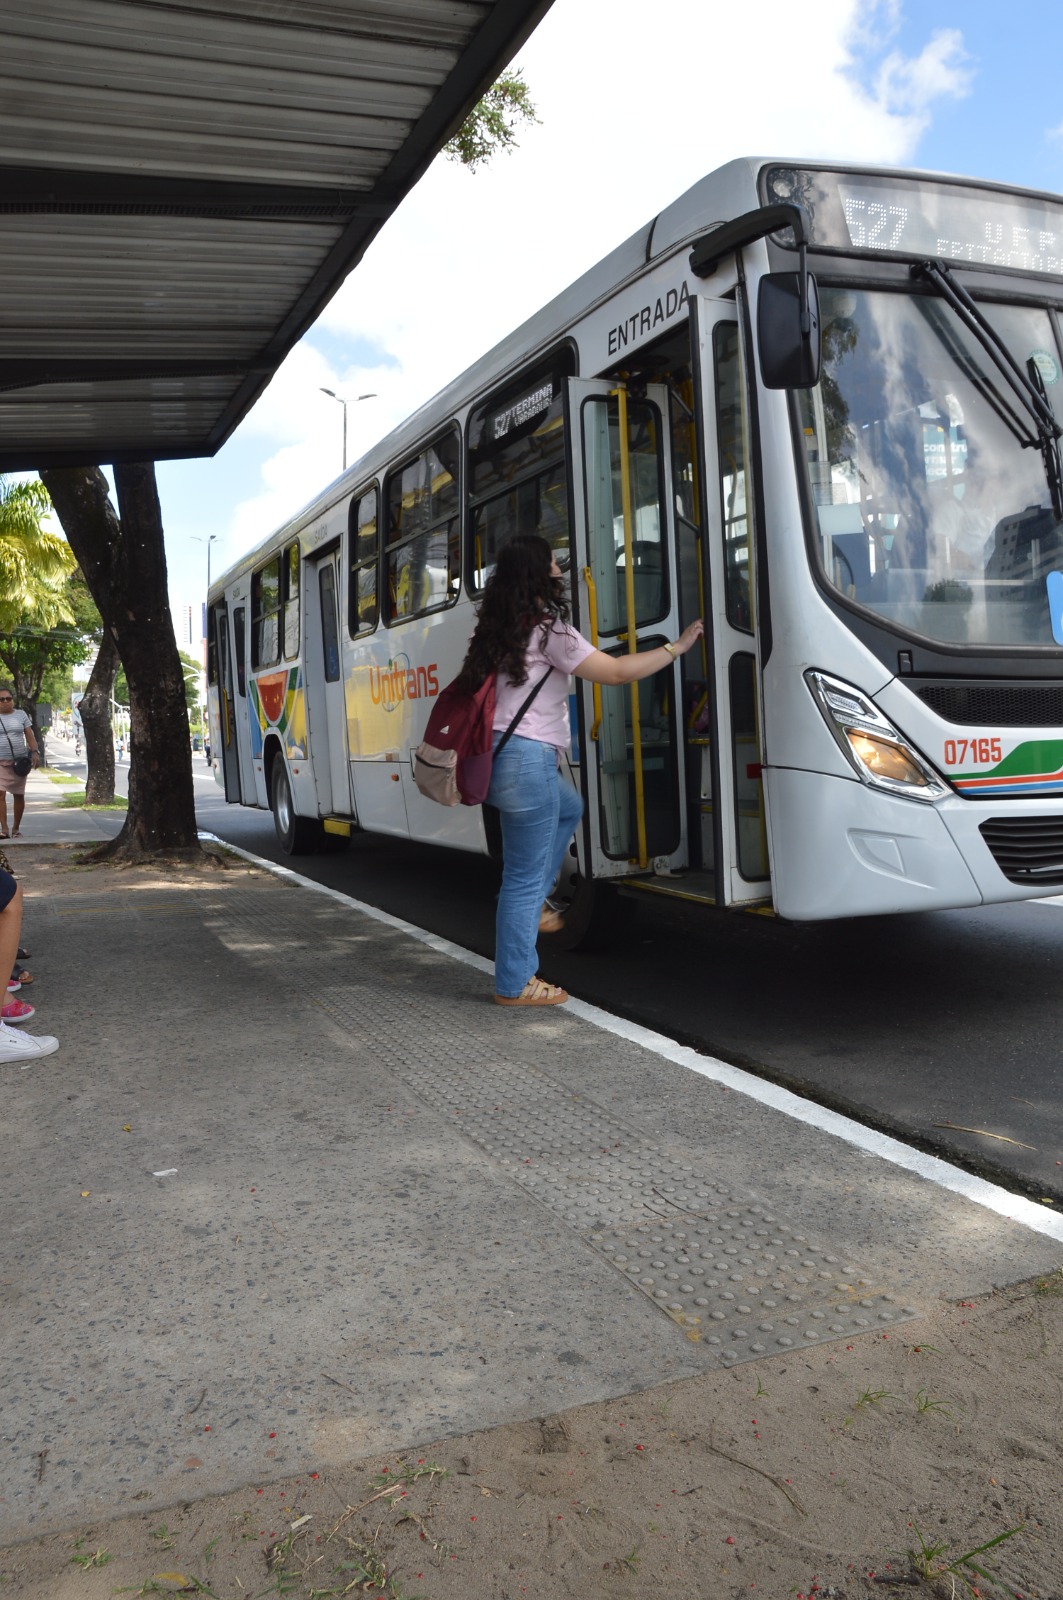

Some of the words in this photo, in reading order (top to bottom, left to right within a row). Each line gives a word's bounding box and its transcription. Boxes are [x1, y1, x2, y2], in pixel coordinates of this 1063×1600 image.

[844, 198, 909, 250] 527
[608, 280, 690, 356] ENTRADA
[494, 409, 511, 440] 527
[369, 659, 439, 705] Unitrans
[944, 738, 1002, 765] 07165
